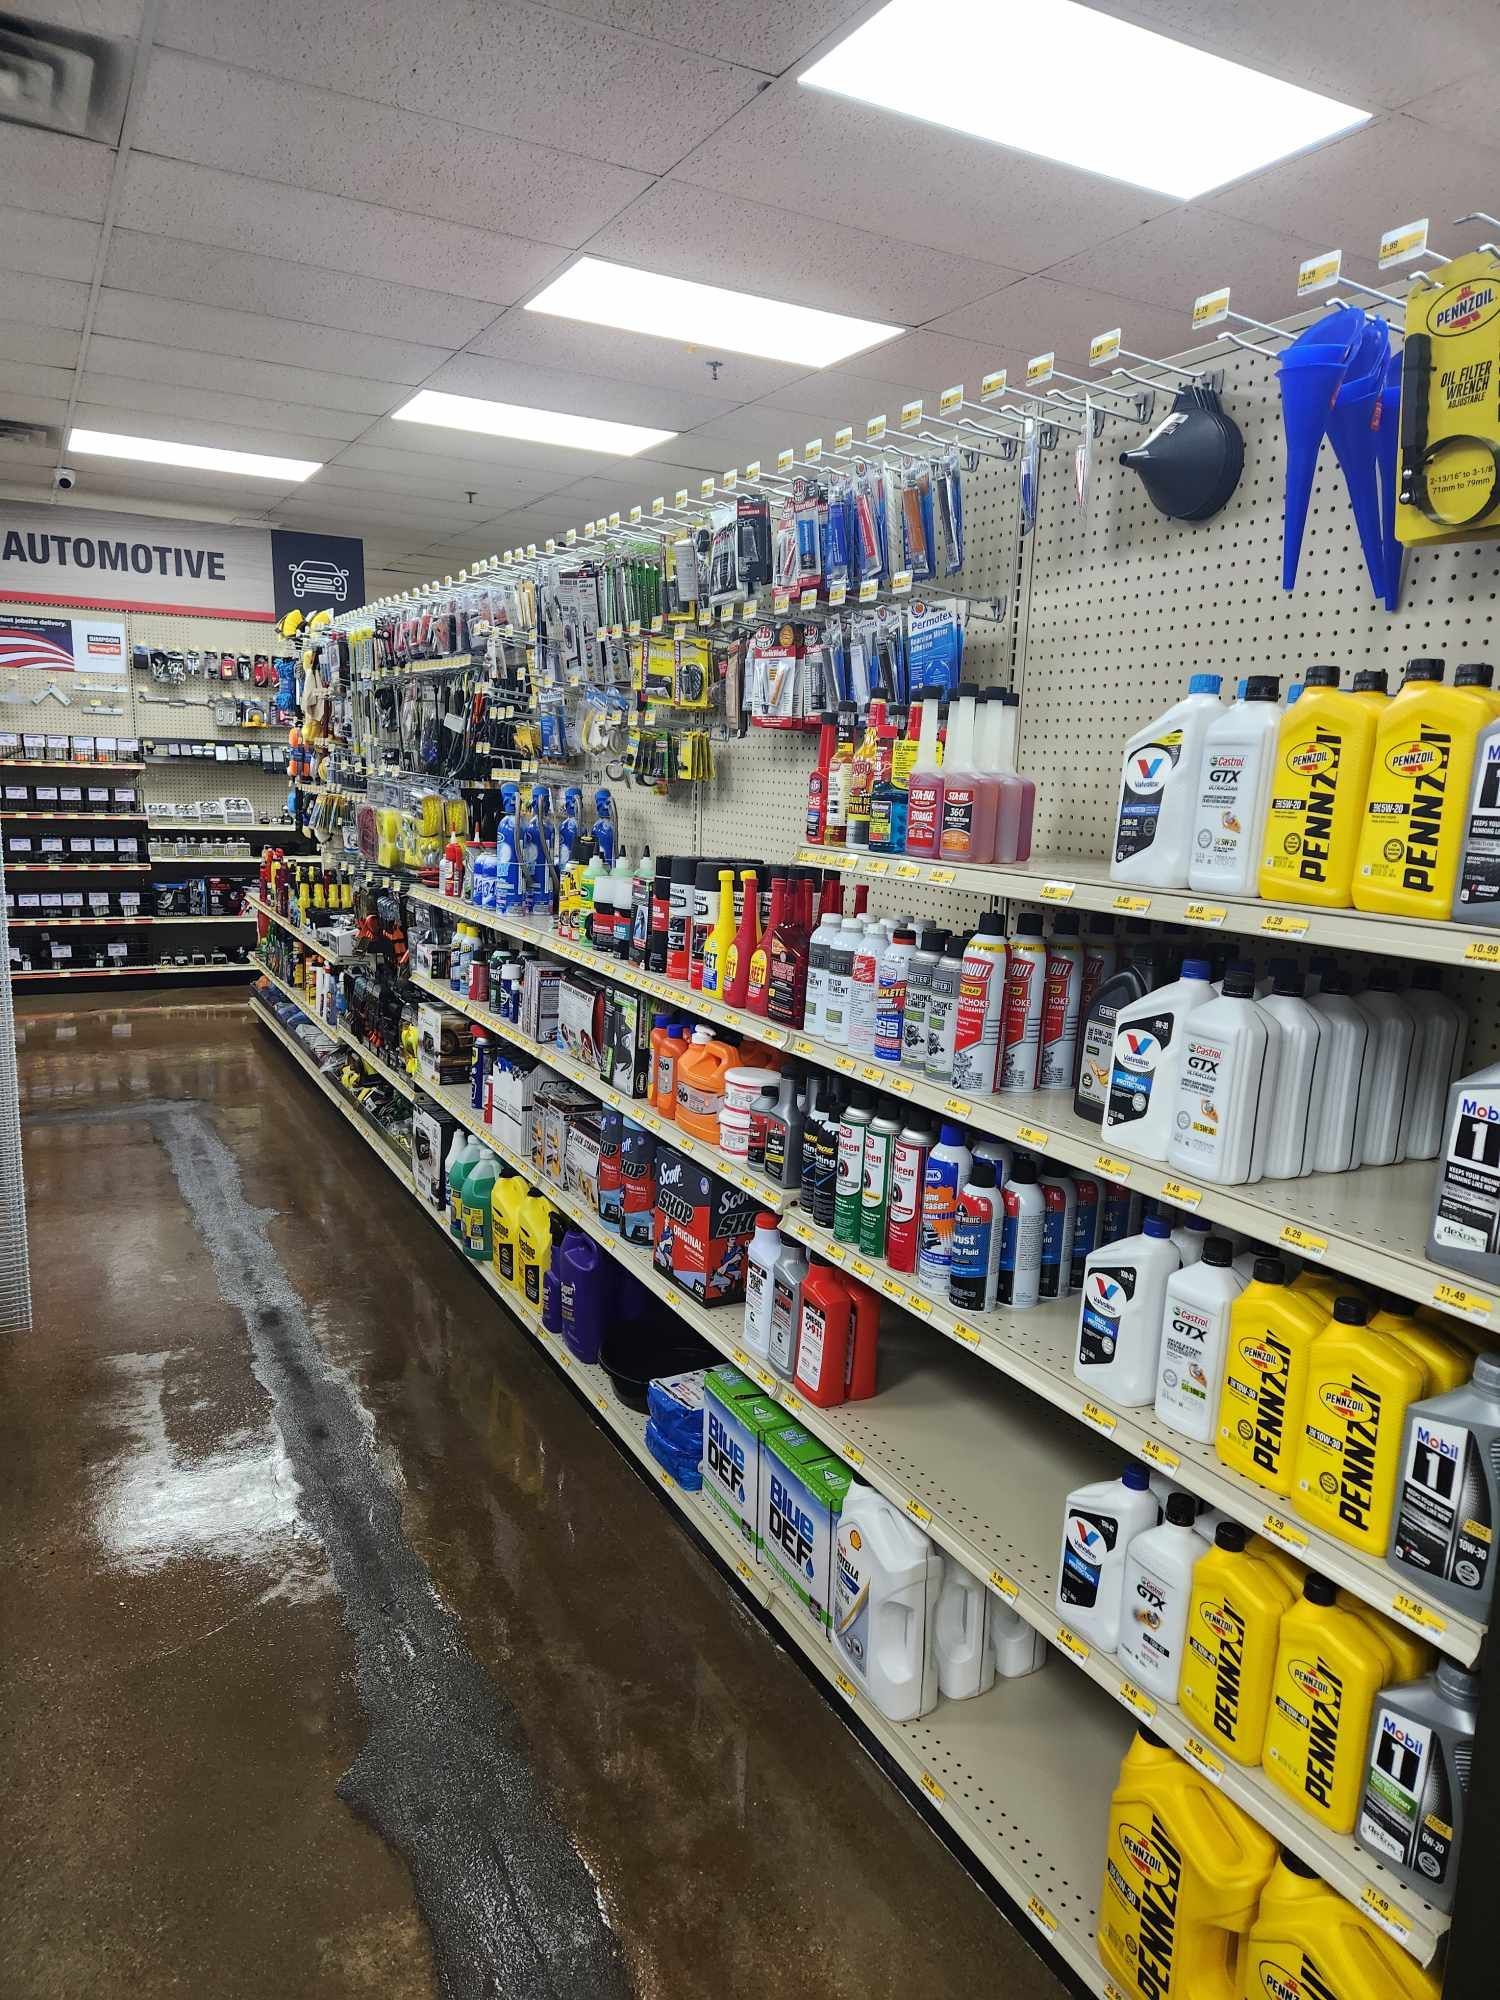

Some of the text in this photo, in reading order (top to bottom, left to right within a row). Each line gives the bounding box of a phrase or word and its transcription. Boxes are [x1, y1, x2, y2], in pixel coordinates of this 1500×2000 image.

[1436, 287, 1494, 328] PENNZOIL
[1440, 360, 1492, 388] OIL FILTER
[1446, 375, 1490, 400] WRENCH
[1448, 391, 1486, 409] ADJUSTABLE
[1432, 485, 1456, 496] 71mm
[1467, 477, 1491, 488] 79mm
[2, 531, 226, 581] AUTOMOTIVE
[911, 608, 953, 632] Permatex
[1218, 756, 1245, 768] Castrol
[1292, 751, 1328, 765] PENNZOIL
[1392, 751, 1434, 767] PENNZOIL
[1209, 769, 1241, 783] GTX
[911, 789, 935, 801] STA-BIL
[947, 792, 969, 801] STA-BIL
[1380, 804, 1404, 815] 5W-20
[1266, 916, 1283, 926] 6.29
[1472, 943, 1499, 955] 10.99
[1123, 1054, 1150, 1067] Valvoline
[1195, 1045, 1222, 1060] Castrol
[1188, 1056, 1220, 1075] GTX
[1462, 1098, 1500, 1121] Mob
[1471, 1121, 1489, 1161] 1
[659, 1162, 681, 1187] Scott
[1448, 1173, 1471, 1186] RUNNING
[1449, 1166, 1464, 1177] KEEPS
[1465, 1170, 1480, 1181] YOUR
[658, 1188, 694, 1225] SHOP
[673, 1224, 703, 1253] ORIGINAL
[1284, 1226, 1302, 1240] 6.29
[1443, 1226, 1476, 1242] dexos
[962, 1248, 979, 1256] Fluid
[1439, 1284, 1466, 1301] 11.49
[1093, 1296, 1115, 1313] Valvoline
[805, 1313, 823, 1330] DIESEL
[1181, 1310, 1209, 1328] Castrol
[1172, 1319, 1208, 1344] GTX
[1243, 1346, 1277, 1365] PENNZOIL
[1235, 1379, 1257, 1400] 10W-30
[1325, 1392, 1364, 1412] PENNZOIL
[708, 1412, 745, 1472] Blue
[1316, 1429, 1341, 1450] 10W-30
[1417, 1426, 1458, 1460] Mobil
[707, 1436, 744, 1493] DEF
[1426, 1451, 1441, 1490] 1
[770, 1474, 814, 1545] Blue
[769, 1501, 813, 1566] DEF
[1267, 1516, 1285, 1530] 6.29
[1073, 1538, 1097, 1560] Valvoline
[1459, 1538, 1487, 1560] 10W-30
[1136, 1584, 1167, 1612] GTX
[1145, 1580, 1165, 1597] Castrol
[1399, 1595, 1423, 1616] 11.49
[1204, 1610, 1233, 1634] PENNZOIL
[1294, 1668, 1329, 1695] PENNZOIL
[1383, 1715, 1423, 1756] Mobil
[1188, 1738, 1204, 1755] 6.29
[1390, 1742, 1406, 1781] 1
[1421, 1831, 1445, 1854] 0W-20
[1123, 1835, 1163, 1874] PENNZOIL
[1366, 1888, 1389, 1912] 11.49
